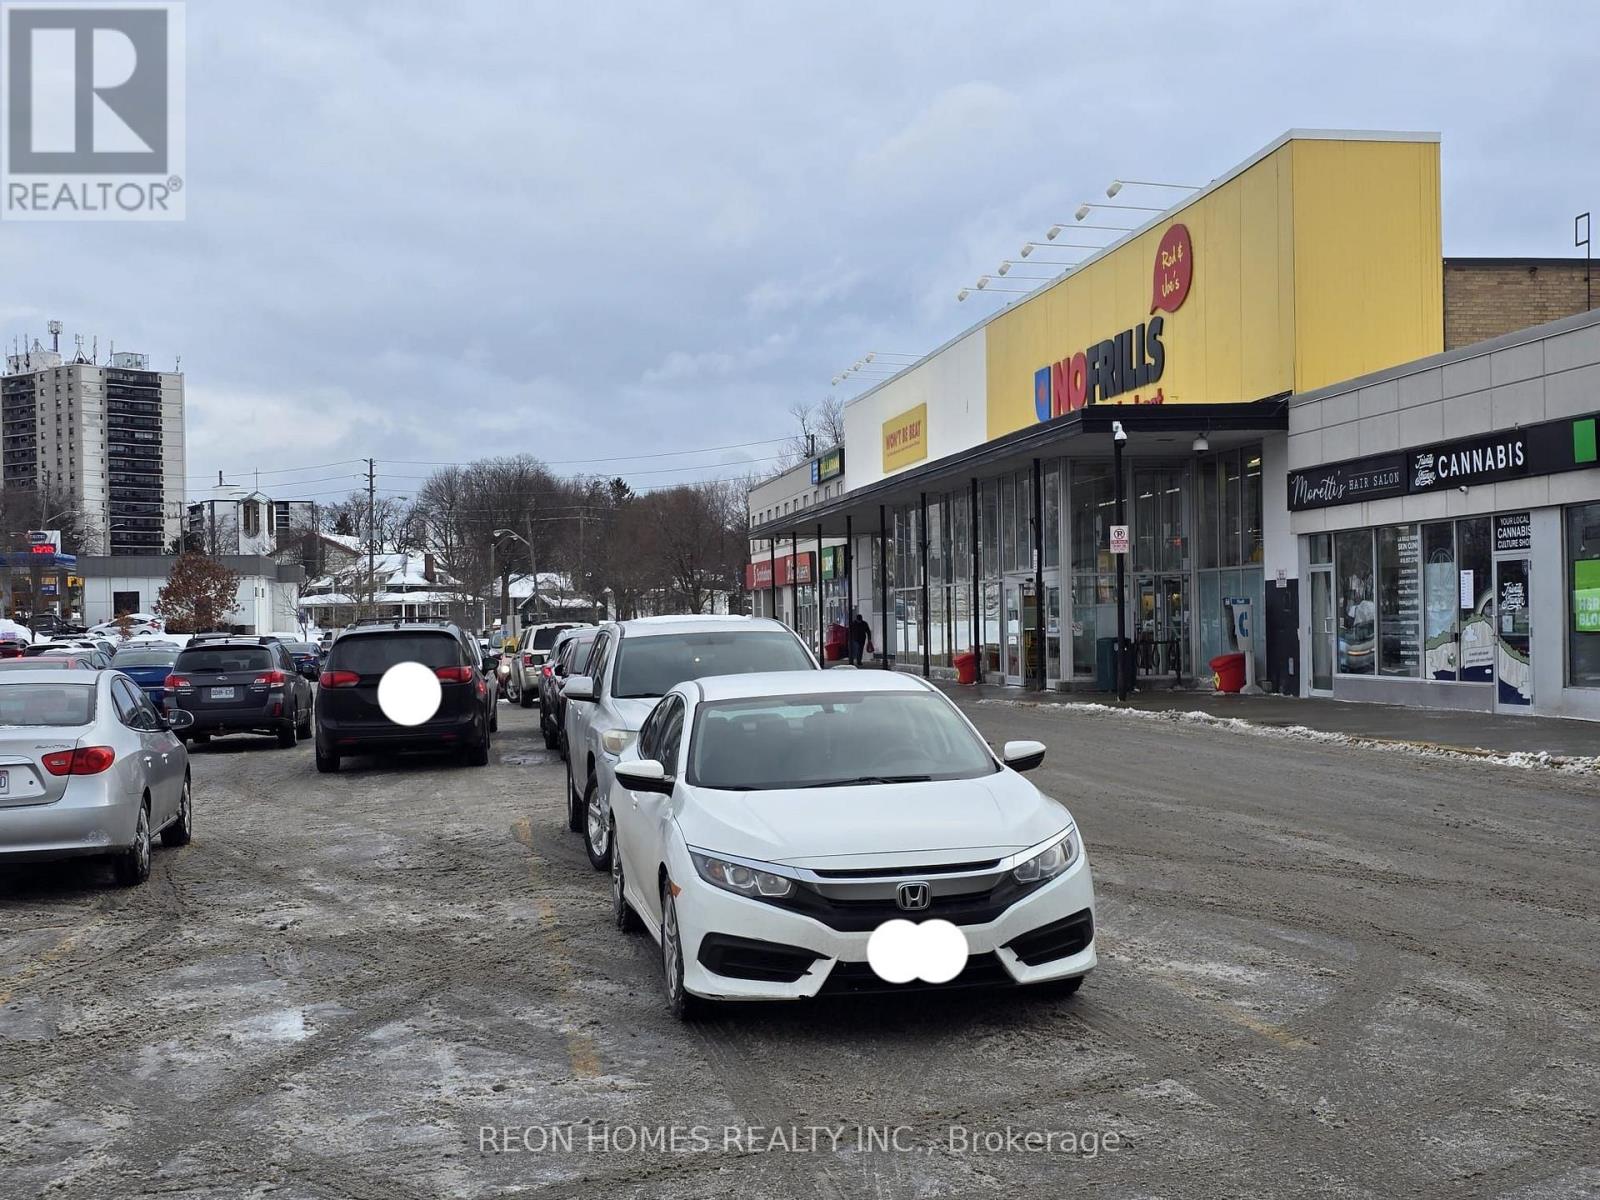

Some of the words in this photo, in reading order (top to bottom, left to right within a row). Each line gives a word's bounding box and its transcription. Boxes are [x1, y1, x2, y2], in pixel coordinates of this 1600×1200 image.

[1438, 441, 1524, 478] CANNABIS
[1291, 470, 1346, 505] Moretti's
[1348, 477, 1370, 491] HAIR
[1373, 472, 1400, 487] SALON
[1499, 517, 1513, 527] YOUR
[1513, 515, 1529, 525] LOCAL
[1497, 525, 1532, 539] CANNABIS
[1497, 539, 1519, 549] CULTURE
[1519, 538, 1531, 547] SHO
[1580, 612, 1600, 626] BLO
